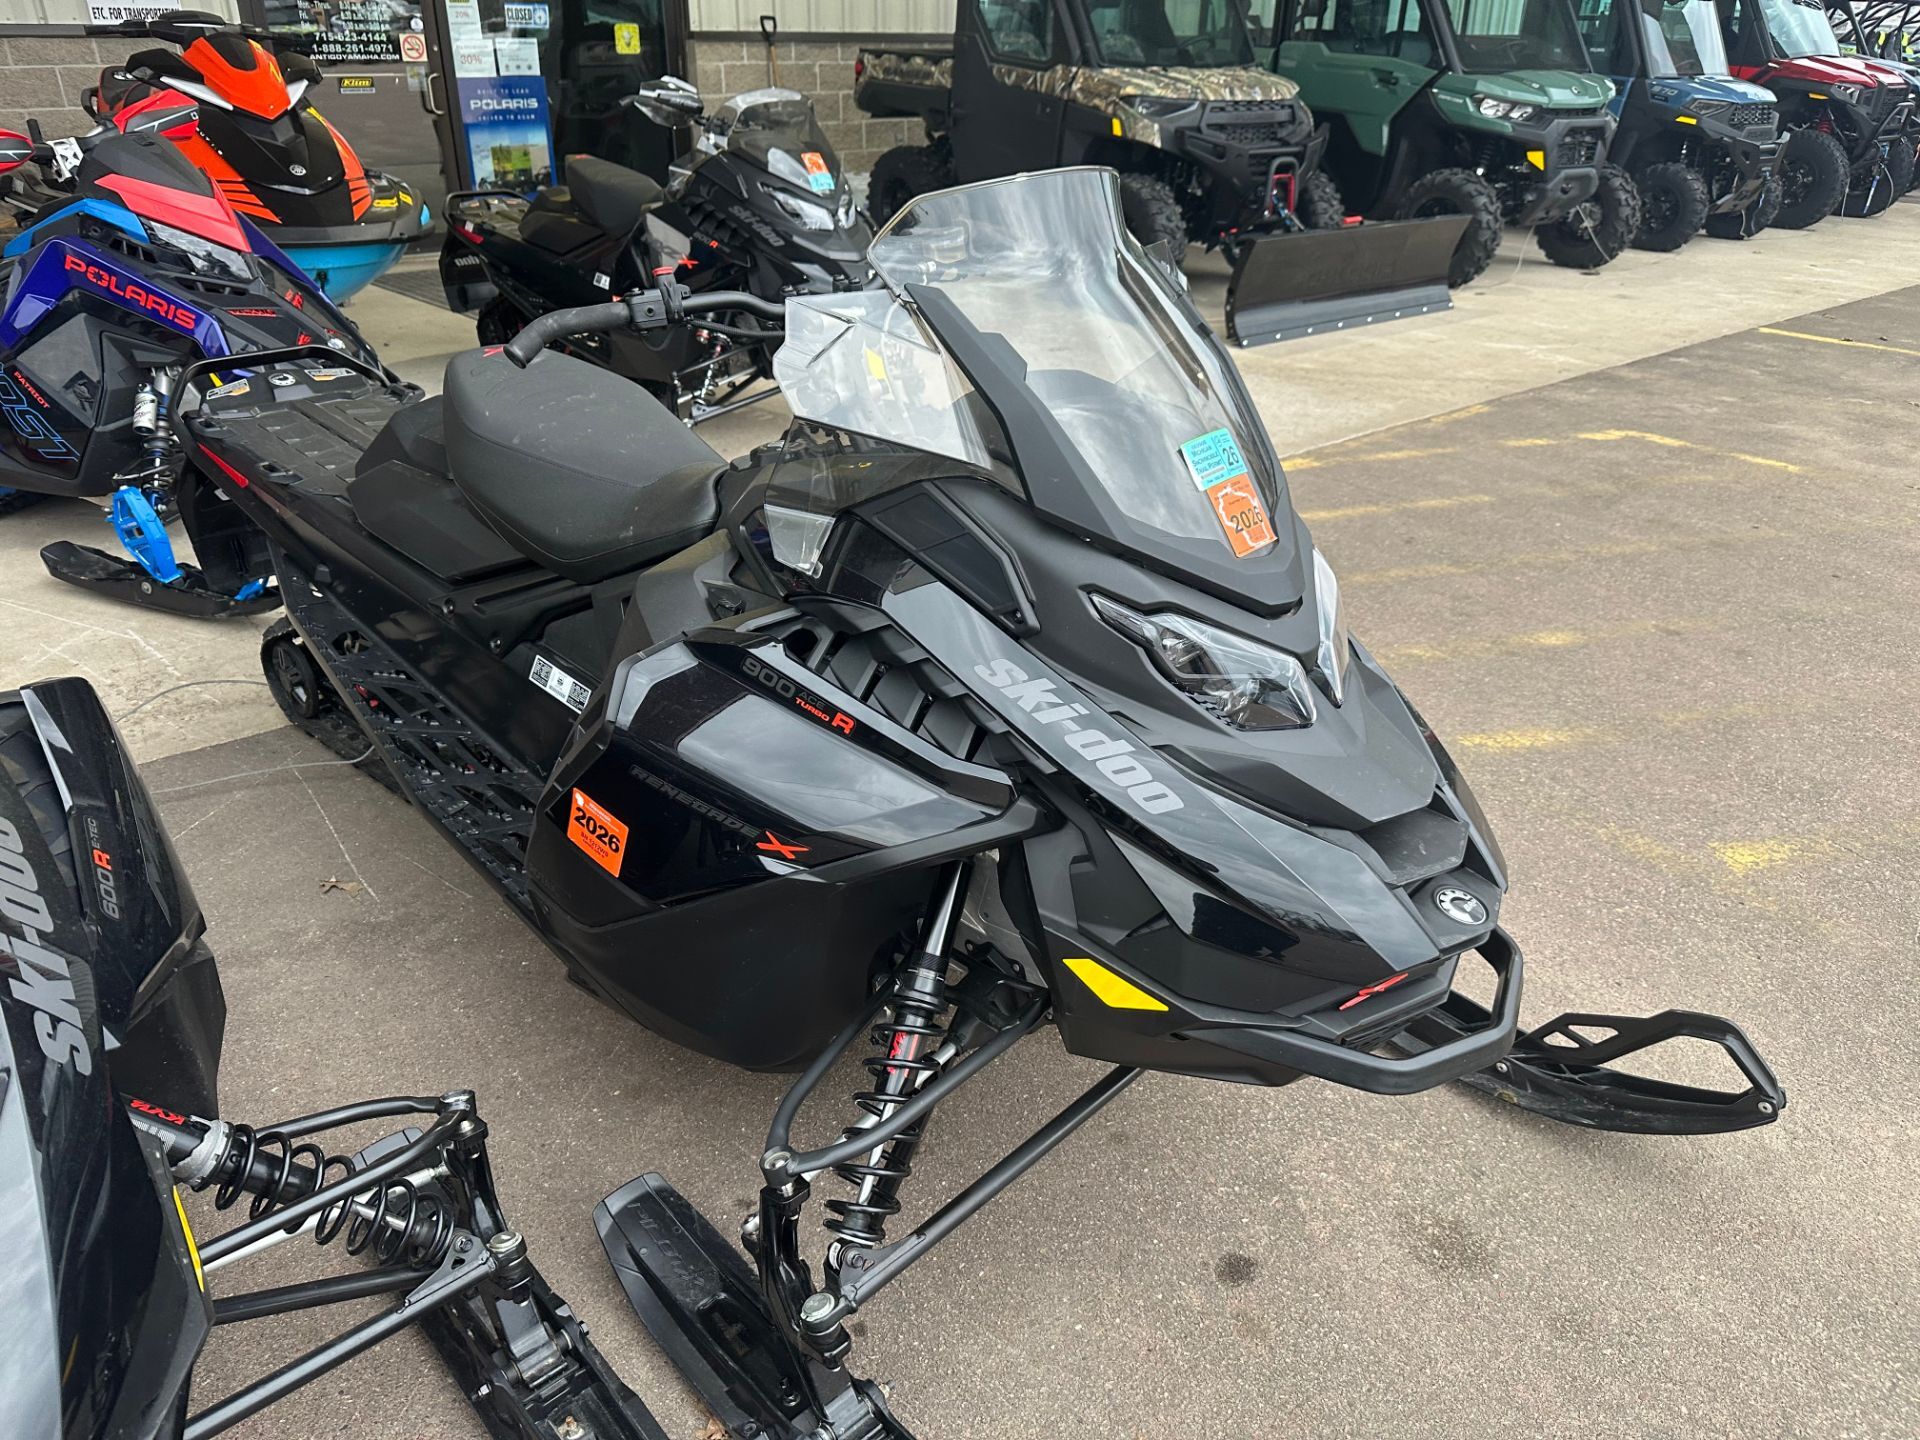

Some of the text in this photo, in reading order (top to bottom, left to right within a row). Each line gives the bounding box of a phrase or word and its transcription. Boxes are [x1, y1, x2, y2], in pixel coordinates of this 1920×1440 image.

[108, 7, 124, 20] FOR
[506, 7, 532, 21] CLOSED
[312, 43, 394, 53] 1-888-261-4971
[314, 32, 388, 42] 715-623-4144
[460, 54, 483, 64] 30%
[470, 97, 539, 110] POLARIS
[64, 254, 197, 330] POLARIS
[14, 370, 51, 409] PATRIOT
[1222, 445, 1240, 466] 26
[1229, 505, 1264, 534] 2026
[742, 657, 855, 735] 900 ACE TURBO R
[630, 764, 762, 838] RENEGADE
[87, 817, 101, 849] E-TEC
[573, 806, 621, 854] 2026
